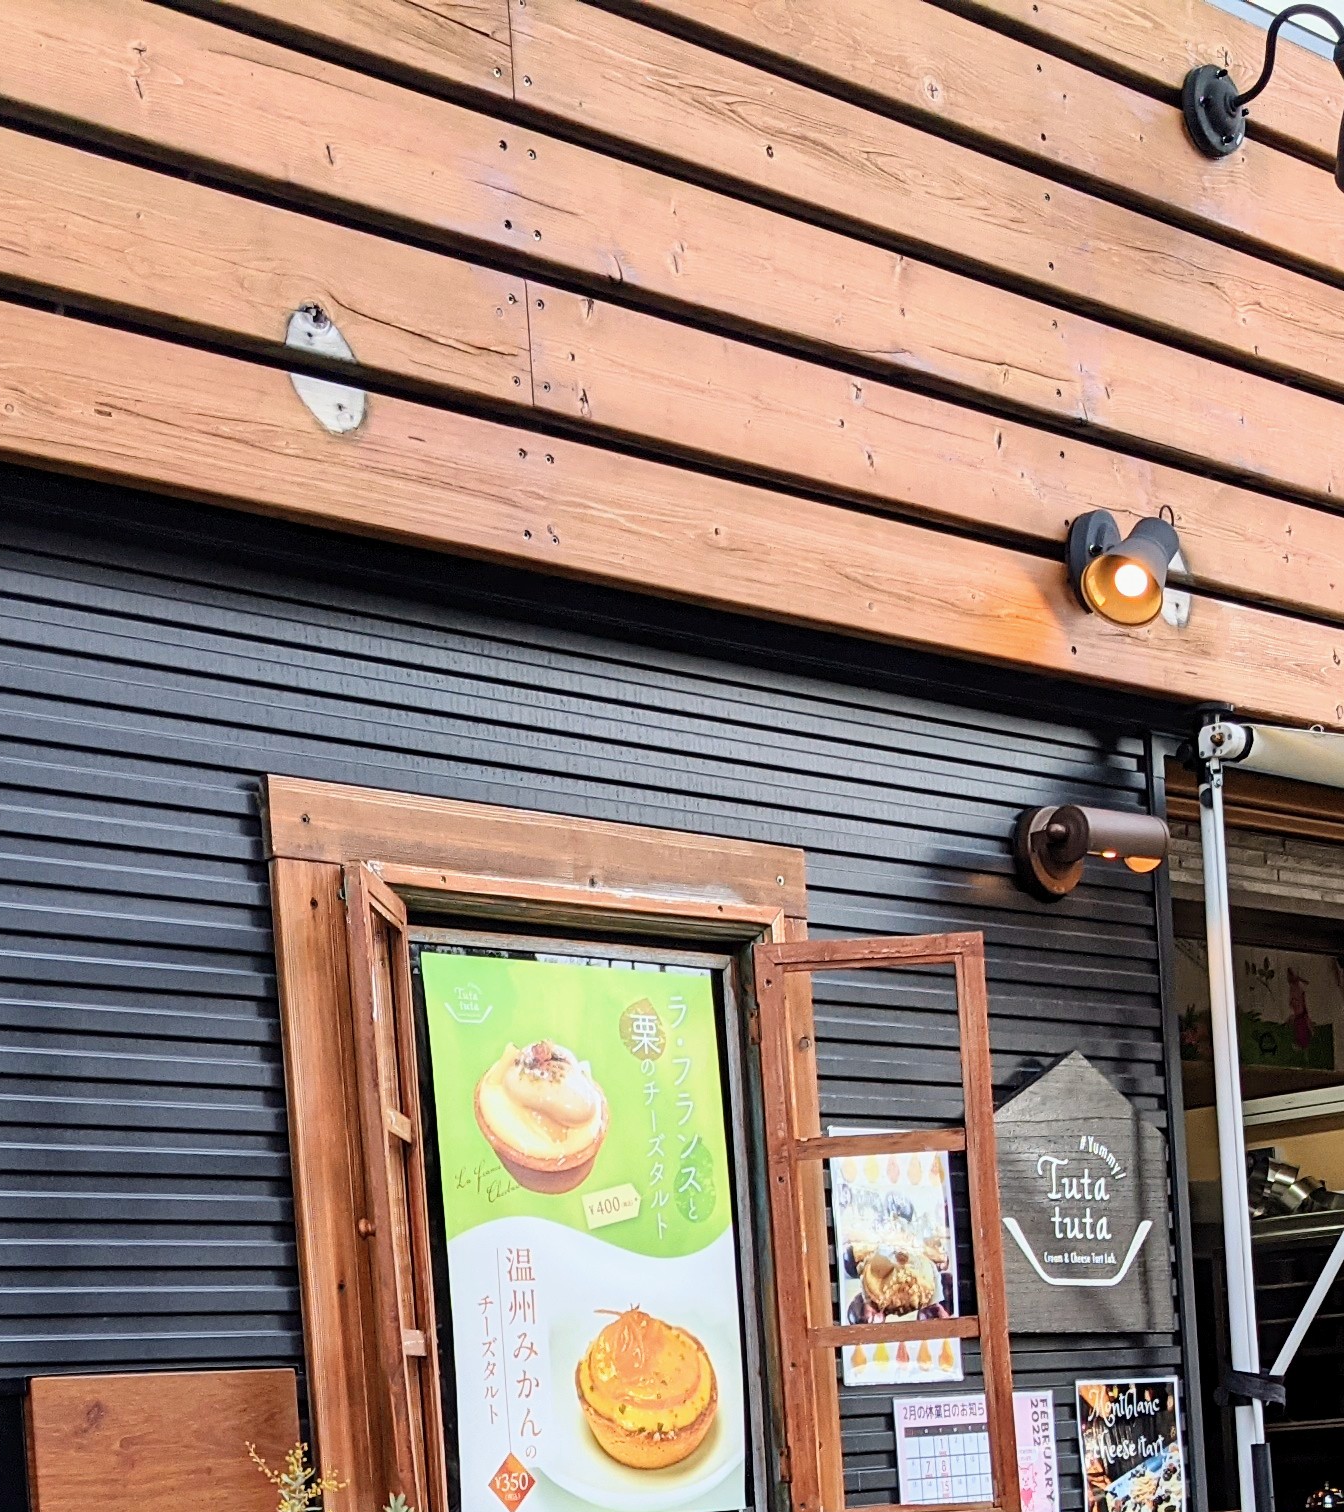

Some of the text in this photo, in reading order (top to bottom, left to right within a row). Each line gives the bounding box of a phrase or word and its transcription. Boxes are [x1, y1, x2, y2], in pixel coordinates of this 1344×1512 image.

[630, 1013, 671, 1240] 栗のチーズタルト
[666, 995, 702, 1222] ラ・フランスと
[1037, 1155, 1110, 1201] Tuta
[1080, 1135, 1127, 1180] #Yummy!
[1051, 1206, 1112, 1240] tuta
[478, 1295, 499, 1425] チーズタルト
[506, 1247, 541, 1459] 温州みかんの
[902, 1402, 986, 1421] 2月の休業日のお知ら
[1031, 1399, 1042, 1447] 2022
[1087, 1388, 1160, 1427] Montblanc
[1039, 1398, 1055, 1502] FEBRUARY
[495, 1472, 529, 1492] ¥350
